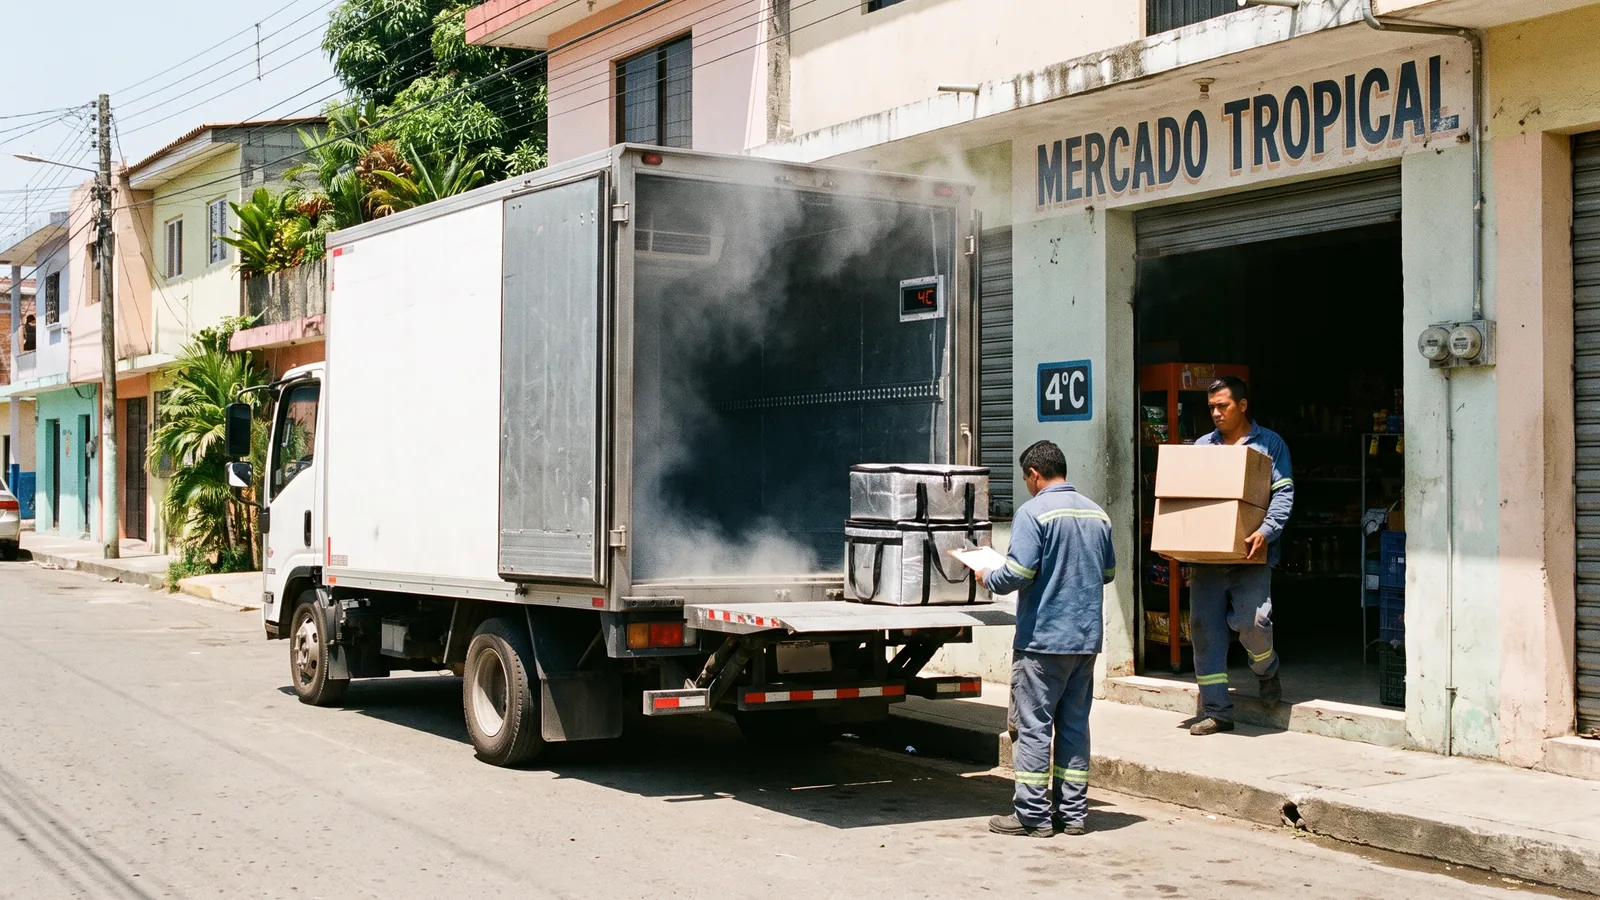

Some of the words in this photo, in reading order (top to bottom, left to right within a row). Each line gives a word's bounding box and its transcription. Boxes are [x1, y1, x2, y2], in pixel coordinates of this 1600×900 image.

[1036, 109, 1208, 205] MERCADO
[1224, 55, 1459, 171] TROPICAL
[1045, 370, 1085, 411] 4°C
